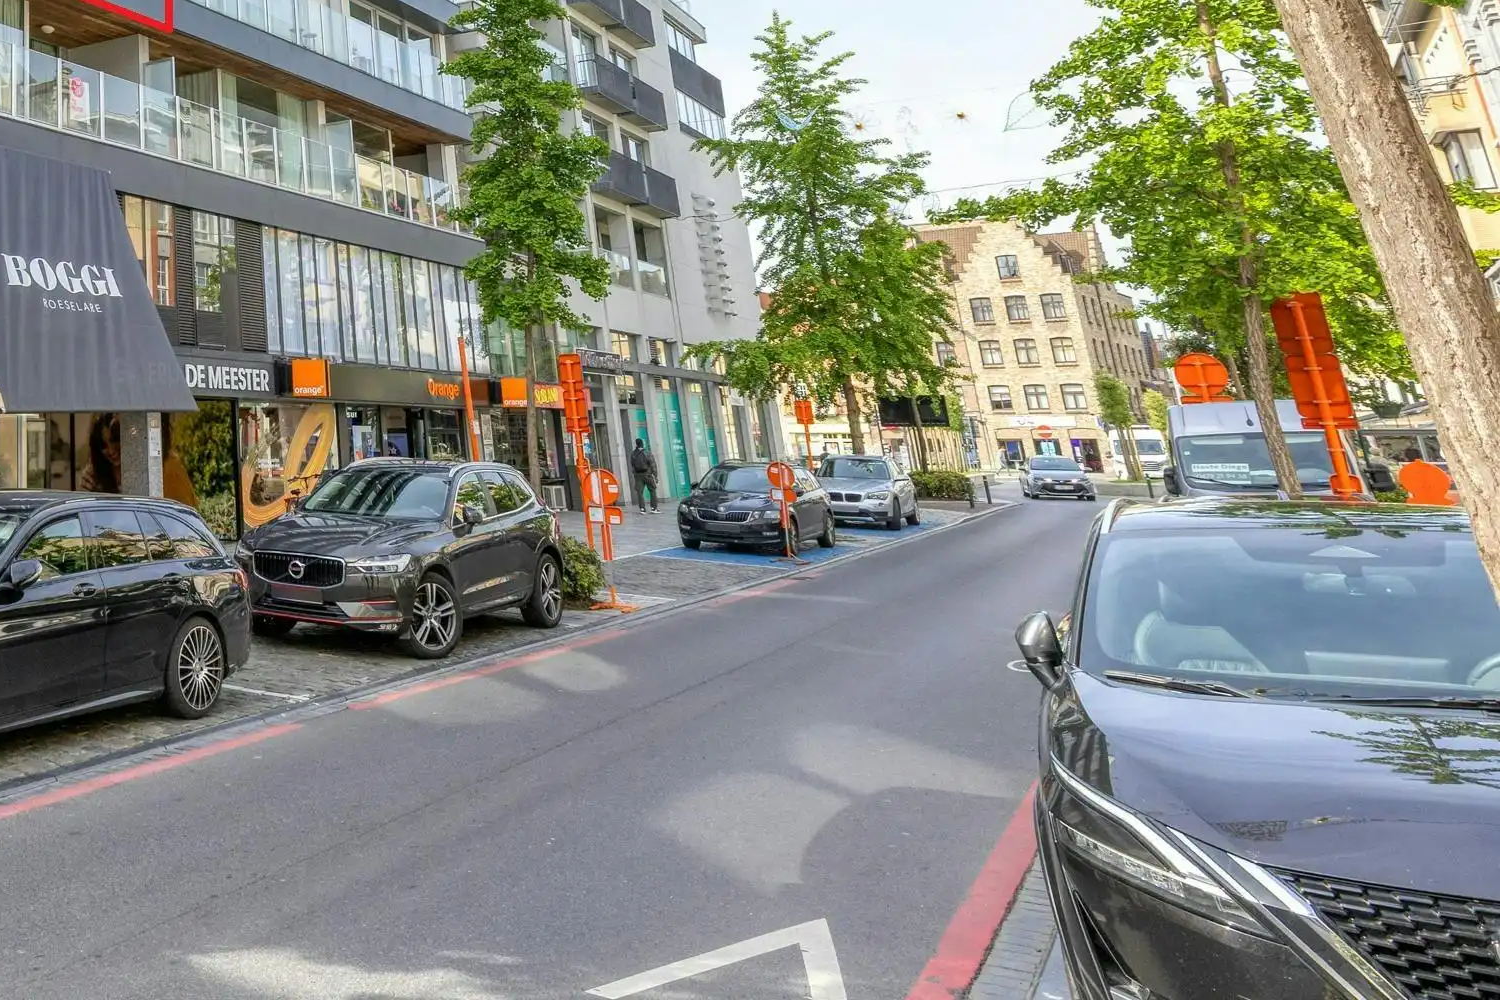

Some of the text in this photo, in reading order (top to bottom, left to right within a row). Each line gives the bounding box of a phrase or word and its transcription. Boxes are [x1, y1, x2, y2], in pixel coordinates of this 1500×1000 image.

[0, 253, 123, 297] BOGGI
[42, 298, 102, 313] ROESELARE
[185, 363, 205, 388] DE
[208, 365, 270, 392] MEESTER
[293, 385, 323, 395] orange
[428, 379, 460, 400] Orange
